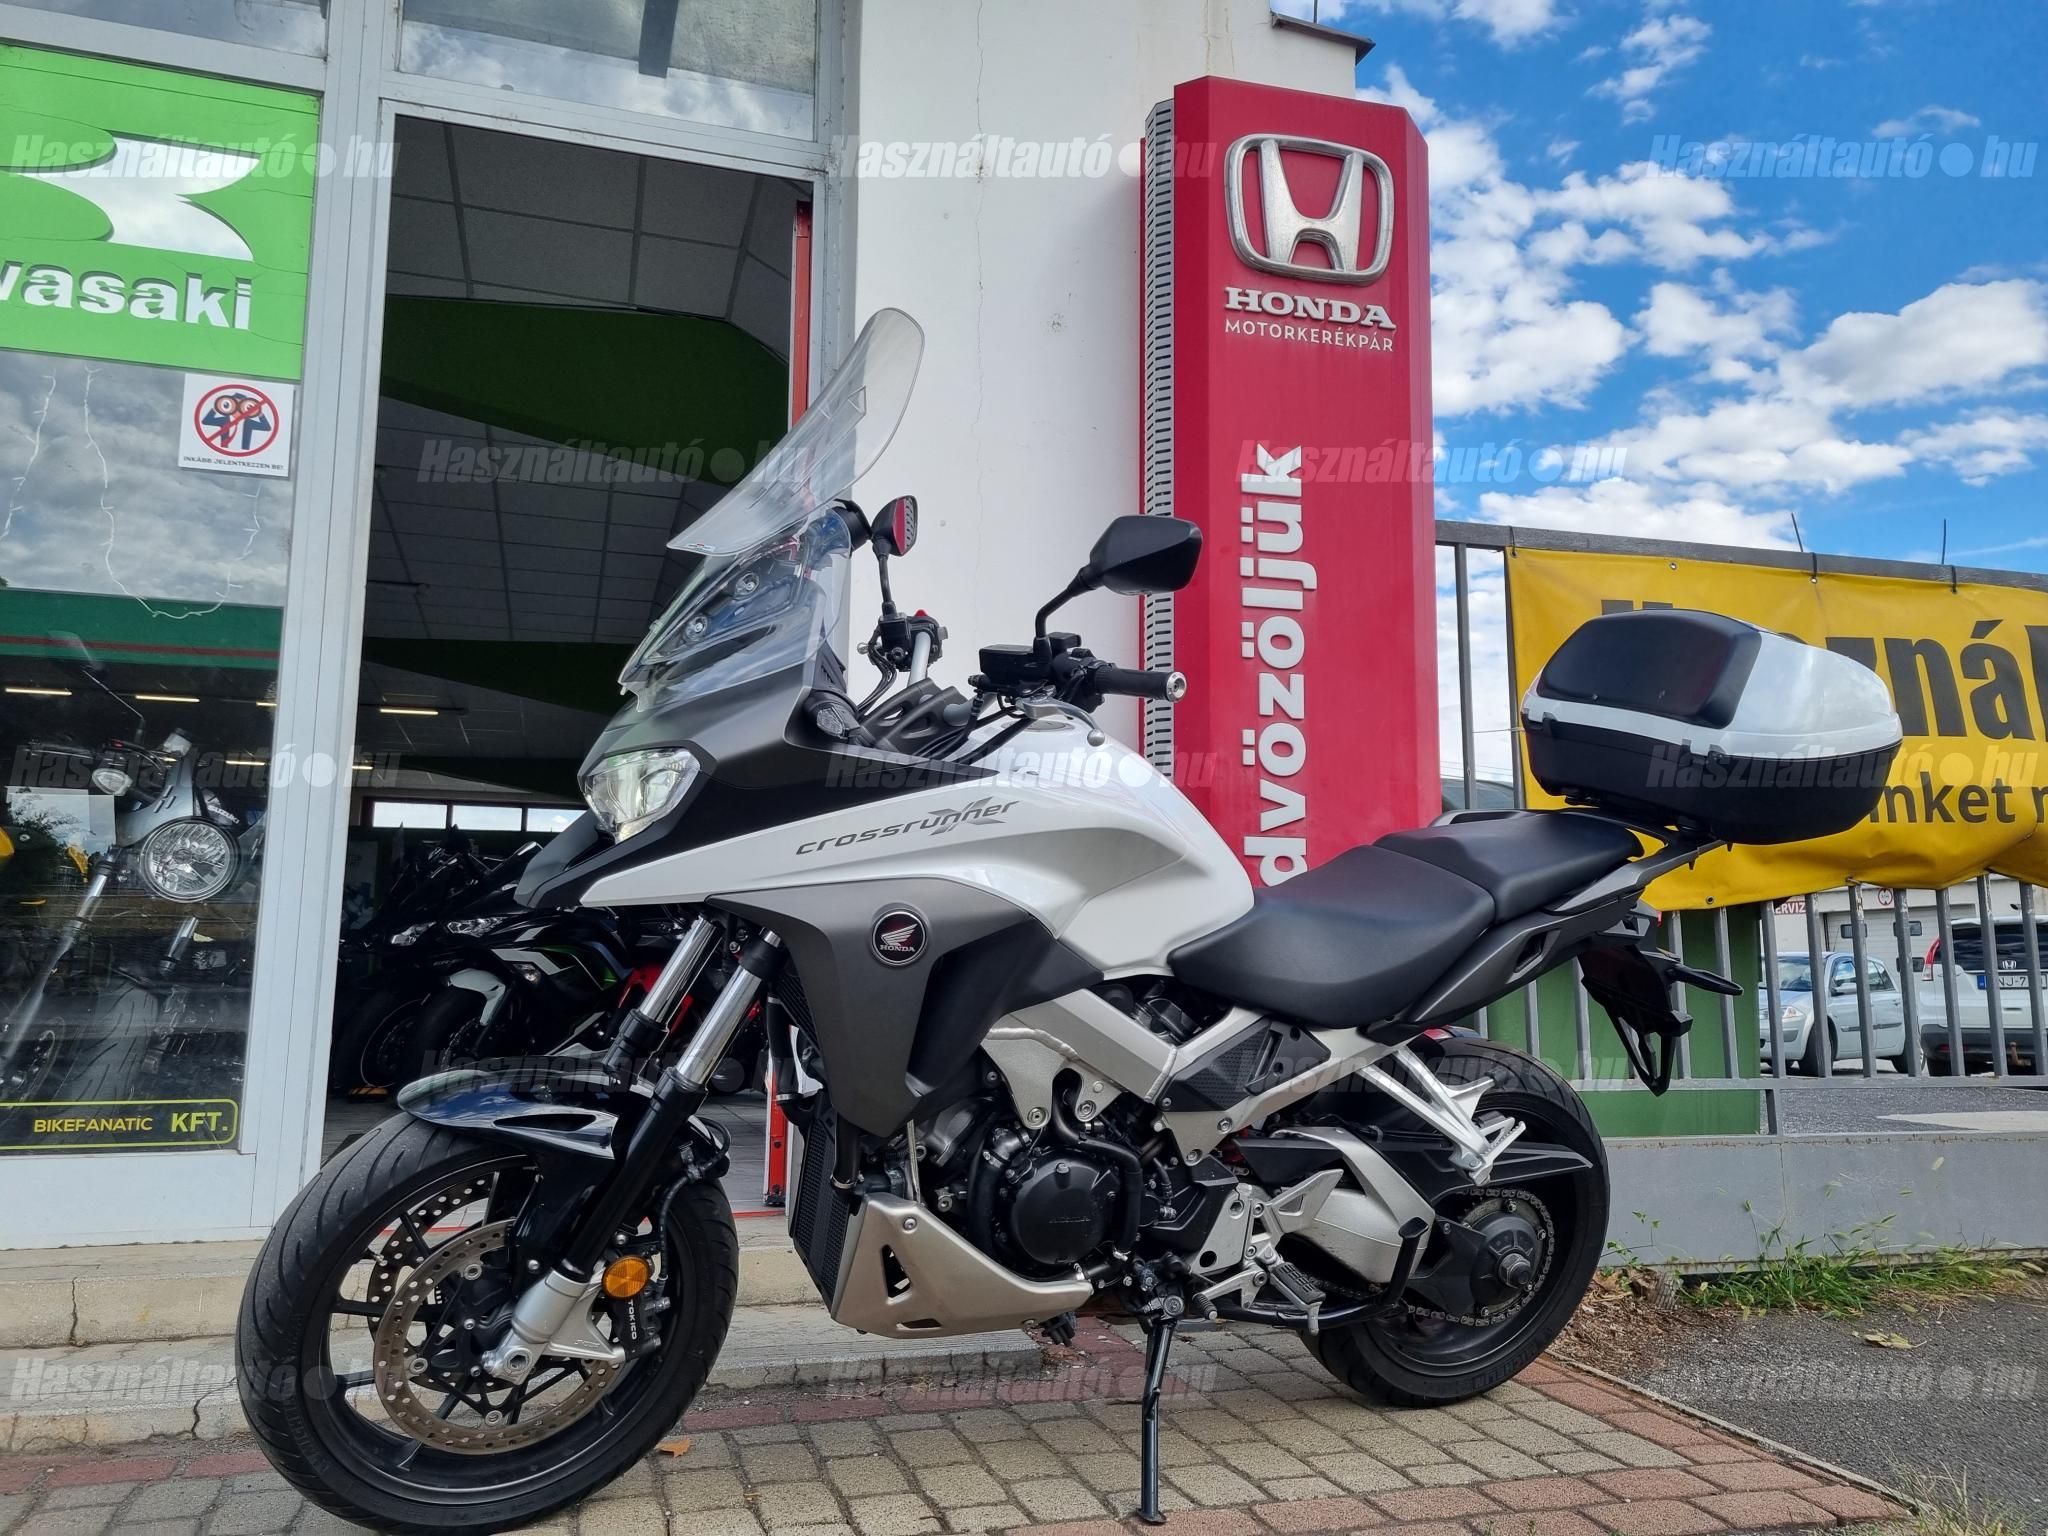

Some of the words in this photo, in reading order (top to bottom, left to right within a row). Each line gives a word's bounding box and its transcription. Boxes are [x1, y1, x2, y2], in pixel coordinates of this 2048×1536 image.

[1225, 287, 1396, 329] HONDA
[1225, 319, 1393, 351] MOTORKERÉKPÁR
[1240, 443, 1317, 887] dvözöljük
[1869, 771, 2016, 823] nket
[1774, 900, 1806, 914] ERVIZ
[880, 944, 916, 952] HONDA
[34, 1117, 153, 1133] BIKEFANATIC
[171, 1111, 228, 1133] KFT.
[628, 1299, 638, 1340] TOKICO
